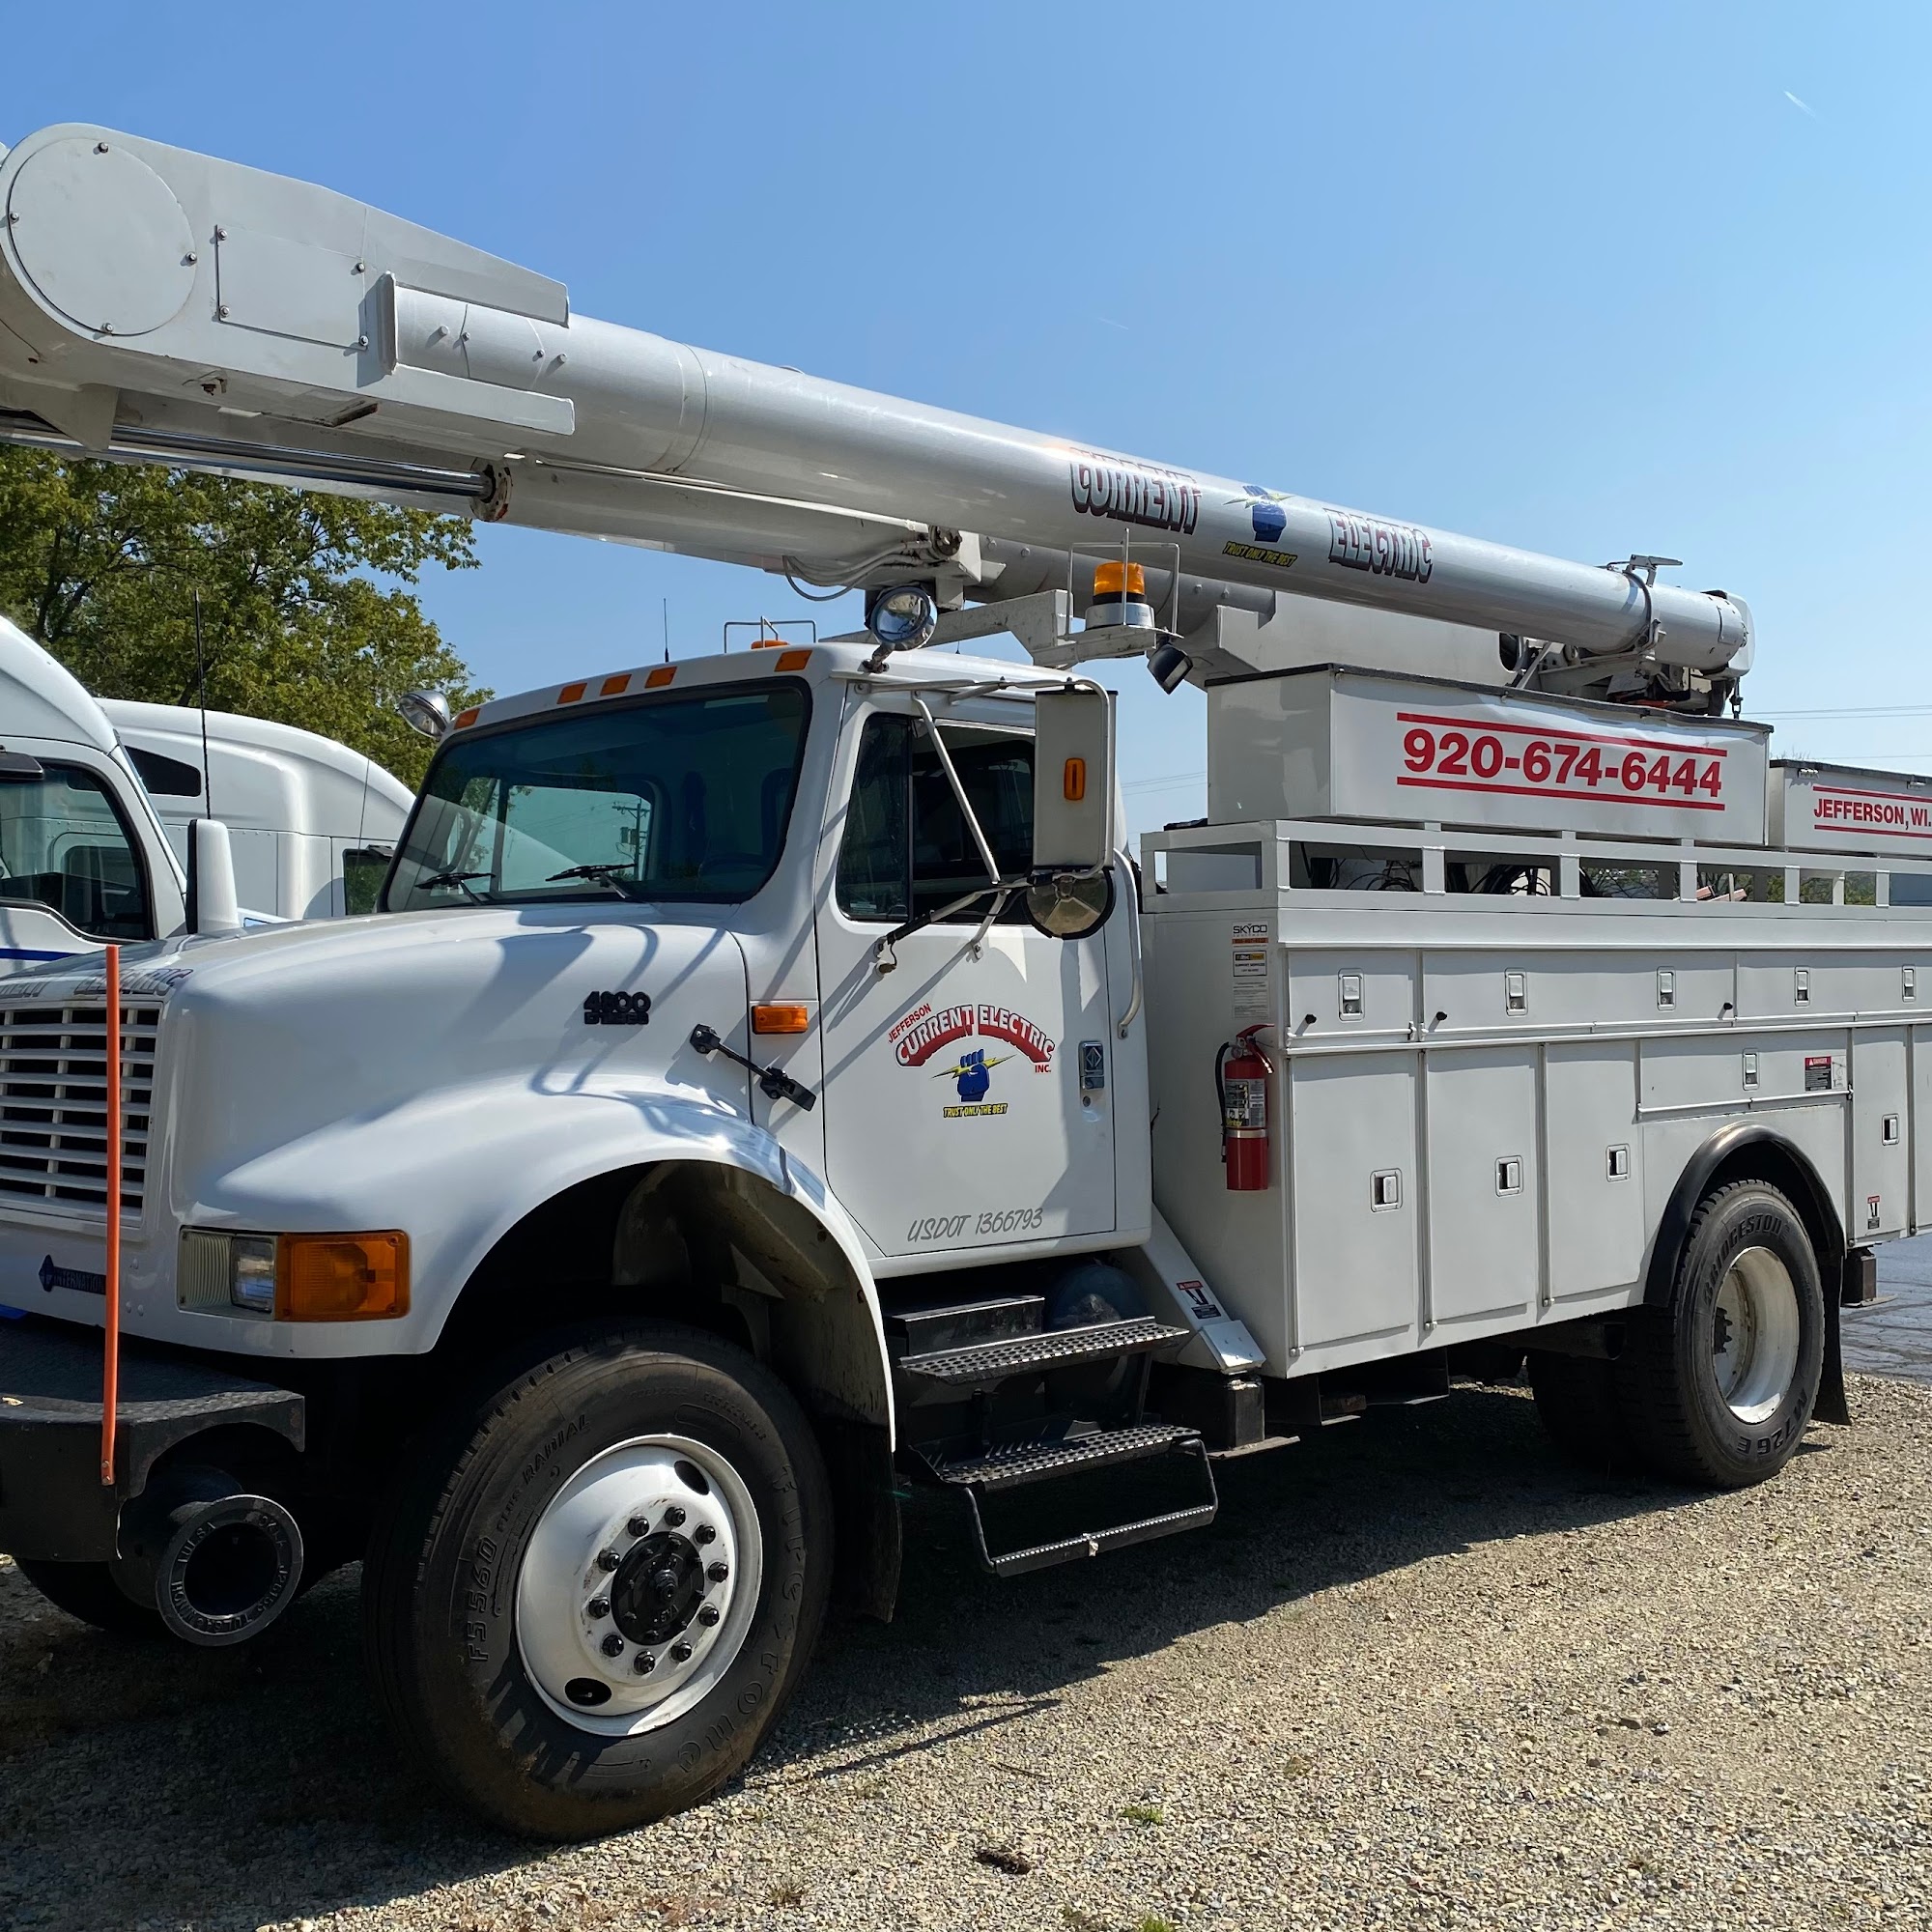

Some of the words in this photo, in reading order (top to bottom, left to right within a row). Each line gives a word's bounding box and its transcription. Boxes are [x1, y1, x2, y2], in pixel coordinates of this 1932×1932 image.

[1069, 447, 1202, 534] CURRENT
[1323, 508, 1434, 584] ELECTRIC
[1222, 541, 1248, 557] TRUST
[1245, 546, 1266, 561] ONLY
[1262, 550, 1280, 564] THE
[1275, 553, 1298, 567] BEST
[1403, 728, 1722, 798] 920-674-6444
[1233, 924, 1267, 933] SKYCO
[888, 1003, 932, 1044] JEFFERSON
[895, 1004, 975, 1066] CURRENT
[978, 1004, 1055, 1063] ELECTRIC
[1035, 1065, 1052, 1073] INC.
[943, 1107, 963, 1118] TRUST
[963, 1105, 980, 1117] ONLY
[980, 1104, 992, 1116] THE
[992, 1103, 1008, 1115] BEST
[907, 1214, 971, 1242] USDOT
[975, 1208, 1043, 1236] 1366793
[1703, 1213, 1792, 1305] BRIDGESTONE
[522, 1414, 591, 1486] RADIAL
